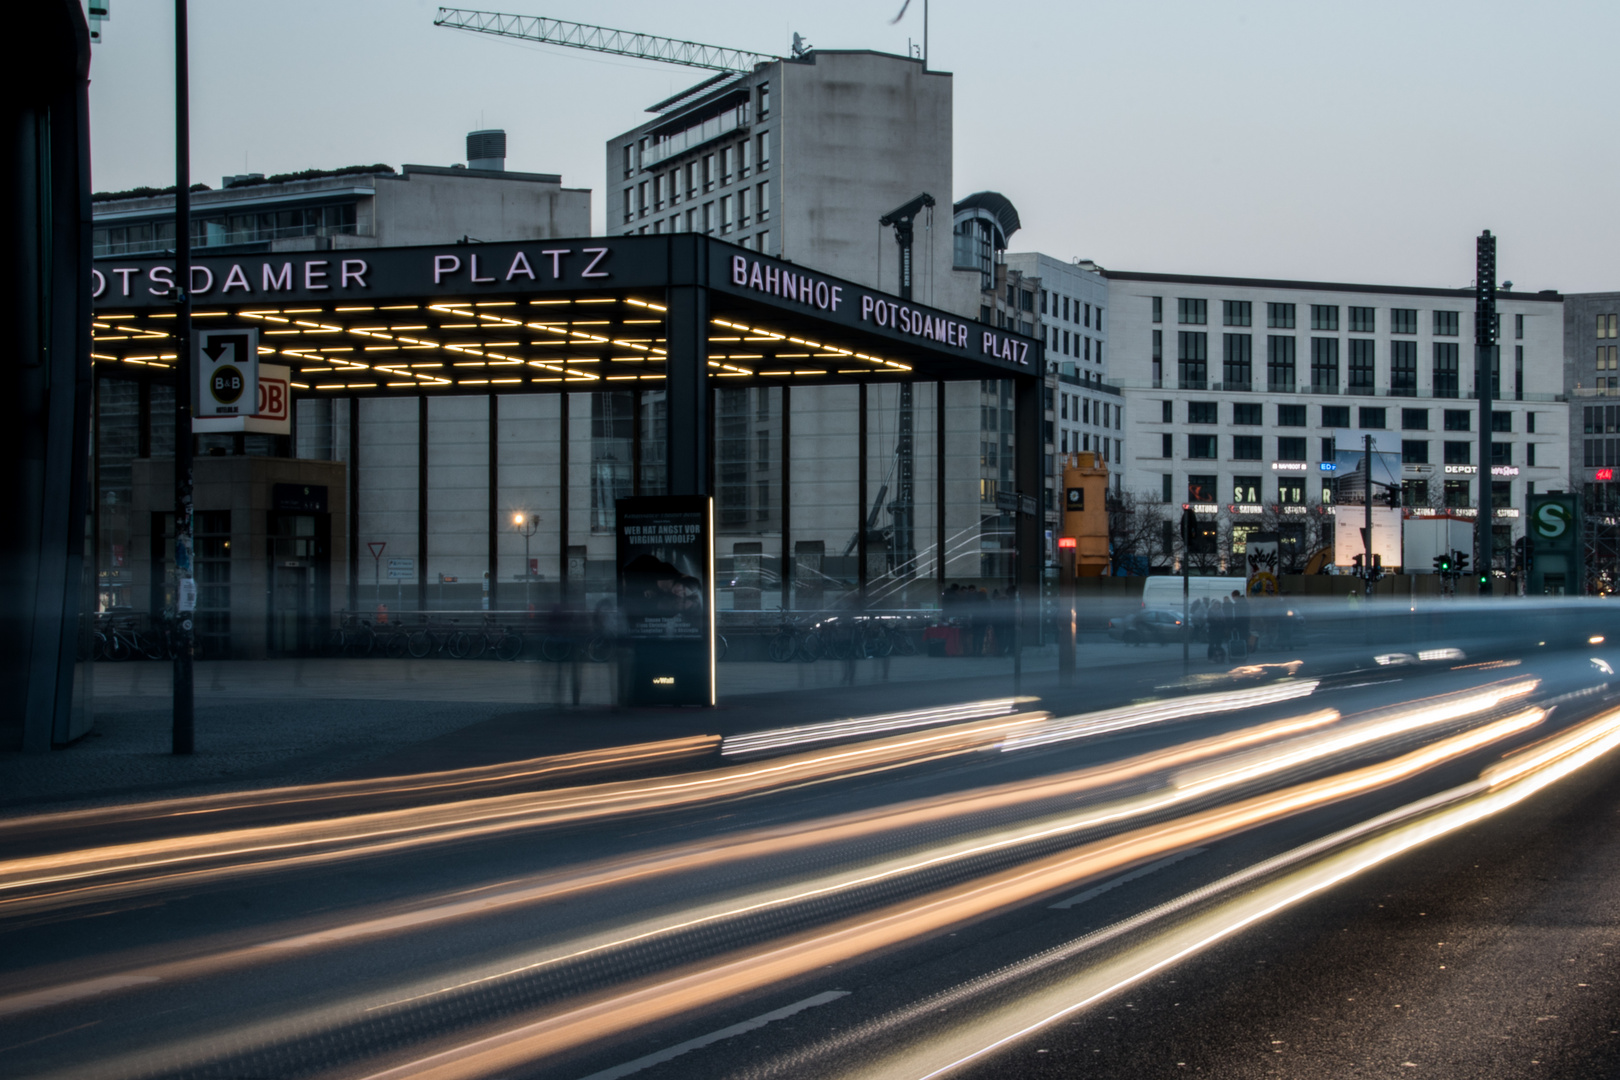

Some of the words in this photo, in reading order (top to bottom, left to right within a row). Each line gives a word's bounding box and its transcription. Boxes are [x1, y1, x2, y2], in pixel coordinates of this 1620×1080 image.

[434, 247, 610, 284] PLATZ
[732, 255, 843, 312] BAHNHOF
[861, 295, 968, 349] POTSDAMER
[982, 332, 1029, 365] PLATZ
[215, 377, 240, 390] B&B
[1194, 505, 1218, 513] SATURN
[1239, 505, 1262, 514] SATURN
[1539, 504, 1566, 537] S
[624, 526, 641, 535] WER
[642, 525, 657, 535] HAT
[658, 525, 683, 534] ANGST
[684, 524, 701, 534] VOR
[629, 535, 663, 544] VIRGINIA
[664, 534, 696, 544] WOOLF?
